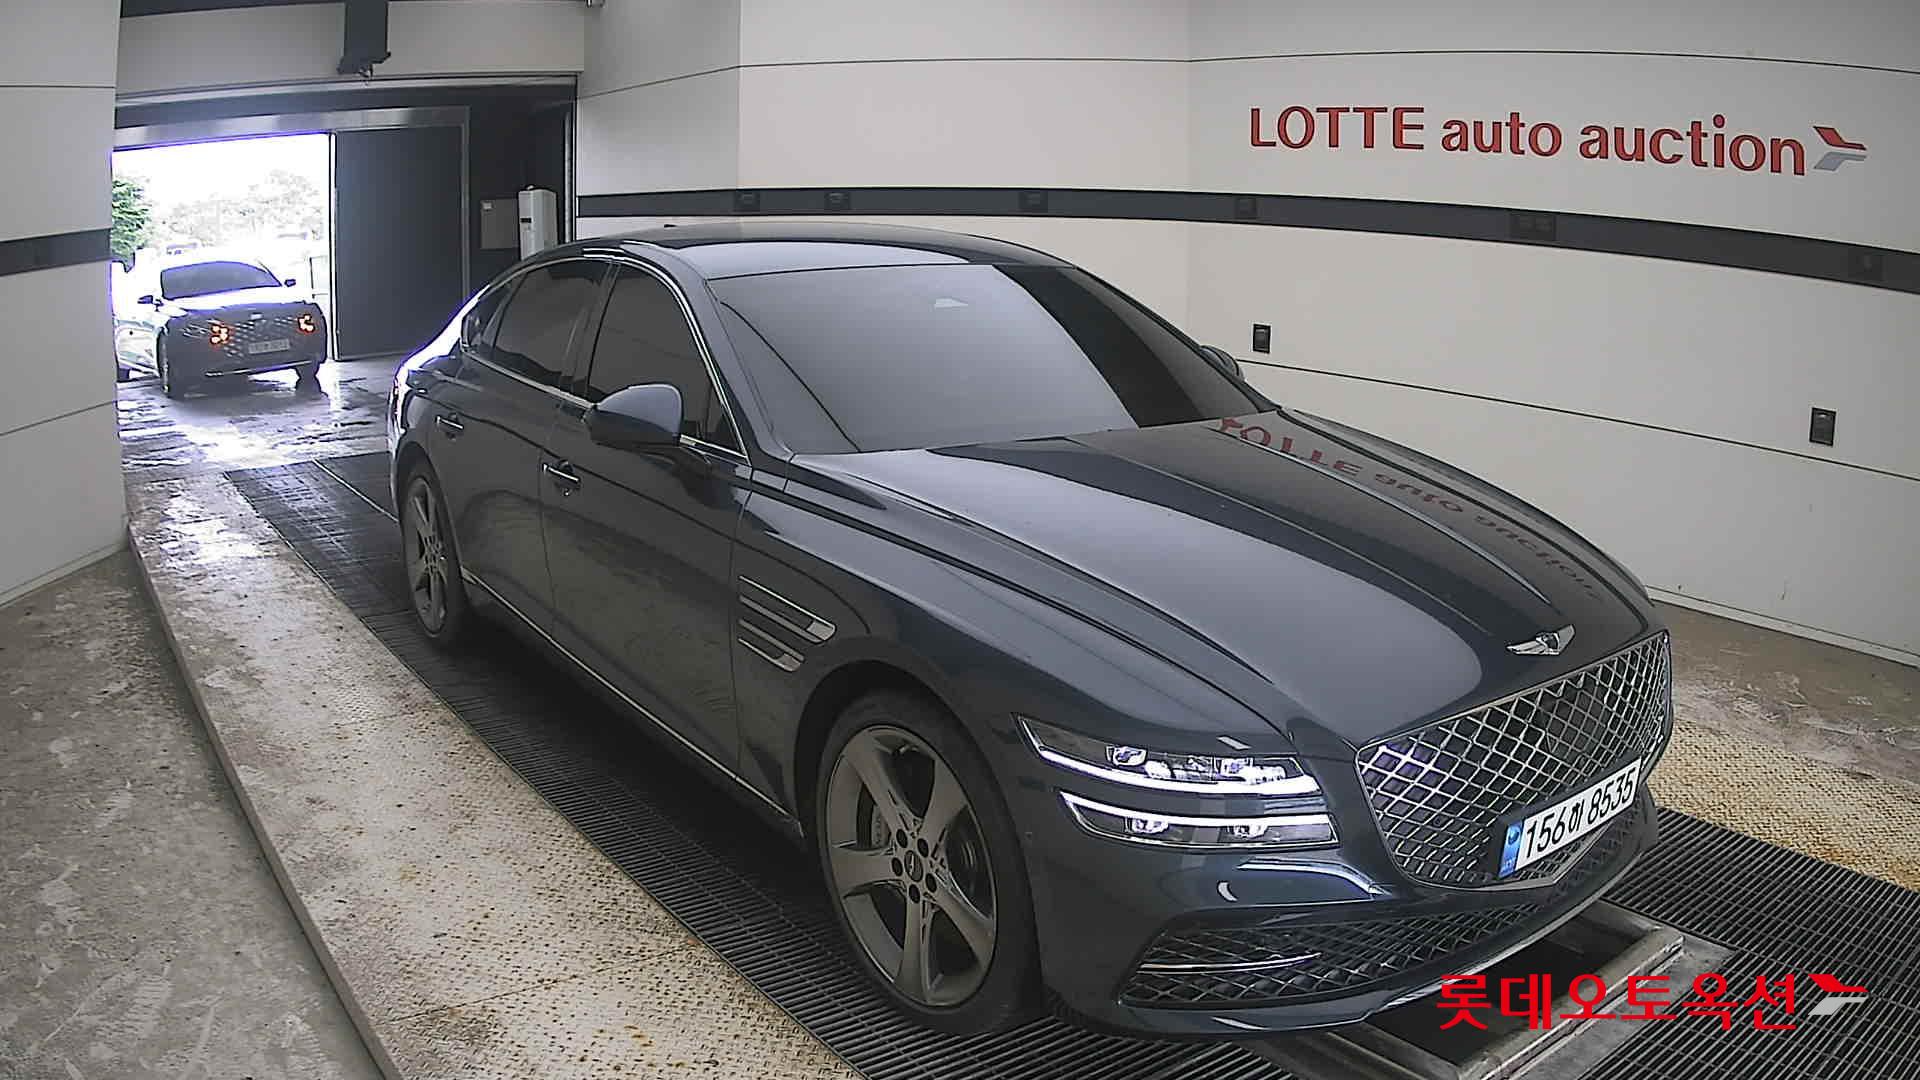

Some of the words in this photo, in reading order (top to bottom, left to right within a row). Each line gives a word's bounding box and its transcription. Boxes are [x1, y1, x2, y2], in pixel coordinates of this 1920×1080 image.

[1250, 105, 1425, 151] LOTTE
[1441, 111, 1563, 157] auto
[1579, 114, 1806, 176] auction
[1587, 767, 1636, 825] 8535
